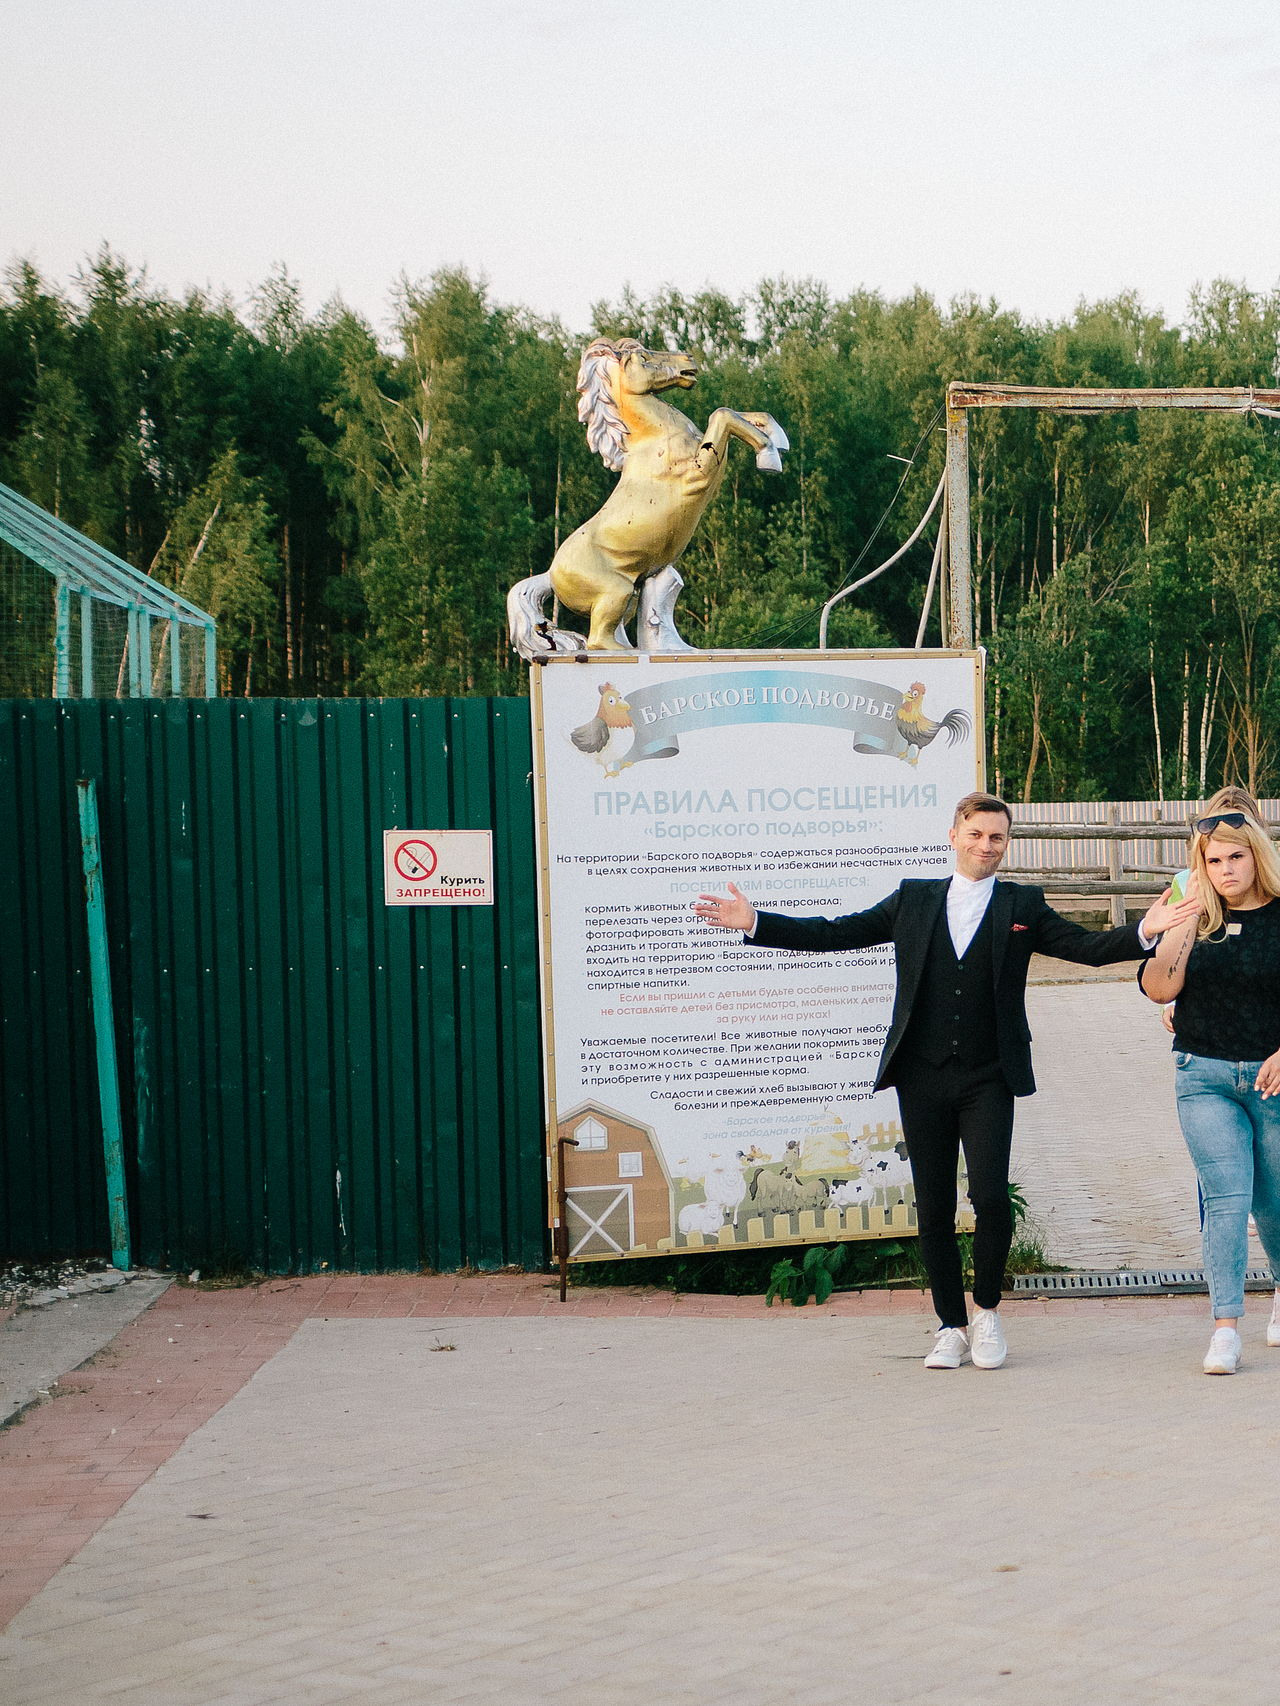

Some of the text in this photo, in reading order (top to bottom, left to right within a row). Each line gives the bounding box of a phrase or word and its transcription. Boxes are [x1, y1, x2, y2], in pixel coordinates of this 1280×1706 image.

[640, 687, 896, 725] БАРСКОЕ ПОДВОРЬЕ
[593, 784, 938, 816] ПРАВИЛА ПОСЕЩЕНИЯ
[644, 818, 884, 842] «Барского подворья»:
[556, 854, 572, 864] На
[575, 854, 640, 866] территории
[760, 848, 833, 860] содержаться
[836, 846, 918, 858] разнообразные
[588, 868, 592, 876] в
[596, 866, 628, 877] целях
[630, 864, 697, 876] сохранения
[700, 862, 751, 872] животных
[764, 862, 776, 871] во
[778, 859, 838, 870] избежании
[840, 858, 902, 868] несчастных
[905, 856, 948, 866] случаев
[440, 876, 485, 887] Курить
[670, 876, 870, 893] ПОСЕТИТЛЯМ ВОСПРЕЩАЕТСЯ:
[396, 888, 485, 898] ЗАПРЕЩЕНО!
[584, 904, 631, 914] кормить
[634, 903, 686, 912] животных
[780, 897, 842, 908] персонала;
[585, 917, 649, 928] перелезать
[651, 915, 684, 925] через
[586, 926, 740, 940] фотографировать животных
[586, 942, 636, 954] дразнить
[639, 942, 646, 950] и
[648, 941, 688, 952] трогать
[586, 956, 630, 966] входить
[632, 954, 646, 964] на
[648, 952, 716, 964] территорию
[776, 950, 826, 959] подвор
[587, 968, 646, 979] находится
[648, 968, 654, 976] в
[656, 964, 713, 975] нетрезвом
[715, 962, 774, 974] состоянии,
[778, 960, 833, 972] приносить
[835, 960, 842, 968] с
[844, 957, 878, 967] собой
[880, 958, 886, 966] и
[587, 978, 690, 992] спиртные напитки.
[620, 993, 646, 1003] Если
[648, 994, 662, 1002] вы
[664, 992, 706, 1002] пришли
[718, 988, 756, 1000] детьми
[758, 987, 794, 998] будьте
[796, 984, 848, 994] особенно
[851, 982, 895, 992] внимате
[601, 994, 893, 1016] не оставляйте детей без присмотра, маленьких детей
[716, 1010, 831, 1024] за руку или на руках!
[580, 1036, 647, 1048] Уважаемые
[652, 1032, 716, 1044] посетители!
[721, 1031, 741, 1041] Все
[745, 1030, 798, 1040] животные
[802, 1026, 852, 1038] получают
[580, 1037, 886, 1061] в достаточном количестве. При желании покормить звер
[581, 1050, 881, 1074] эту возможность с администрацией «Барско
[591, 1074, 662, 1086] приобретите
[664, 1074, 670, 1083] у
[673, 1072, 692, 1081] них
[694, 1068, 770, 1081] разрешенные
[772, 1066, 810, 1077] корма.
[650, 1080, 876, 1100] Сладости и свежий хлеб вызывают у живо
[674, 1101, 720, 1112] болезни
[730, 1095, 834, 1108] преждевременную
[836, 1092, 877, 1104] смерть.
[702, 1131, 728, 1140] зона
[730, 1125, 789, 1138] свободная
